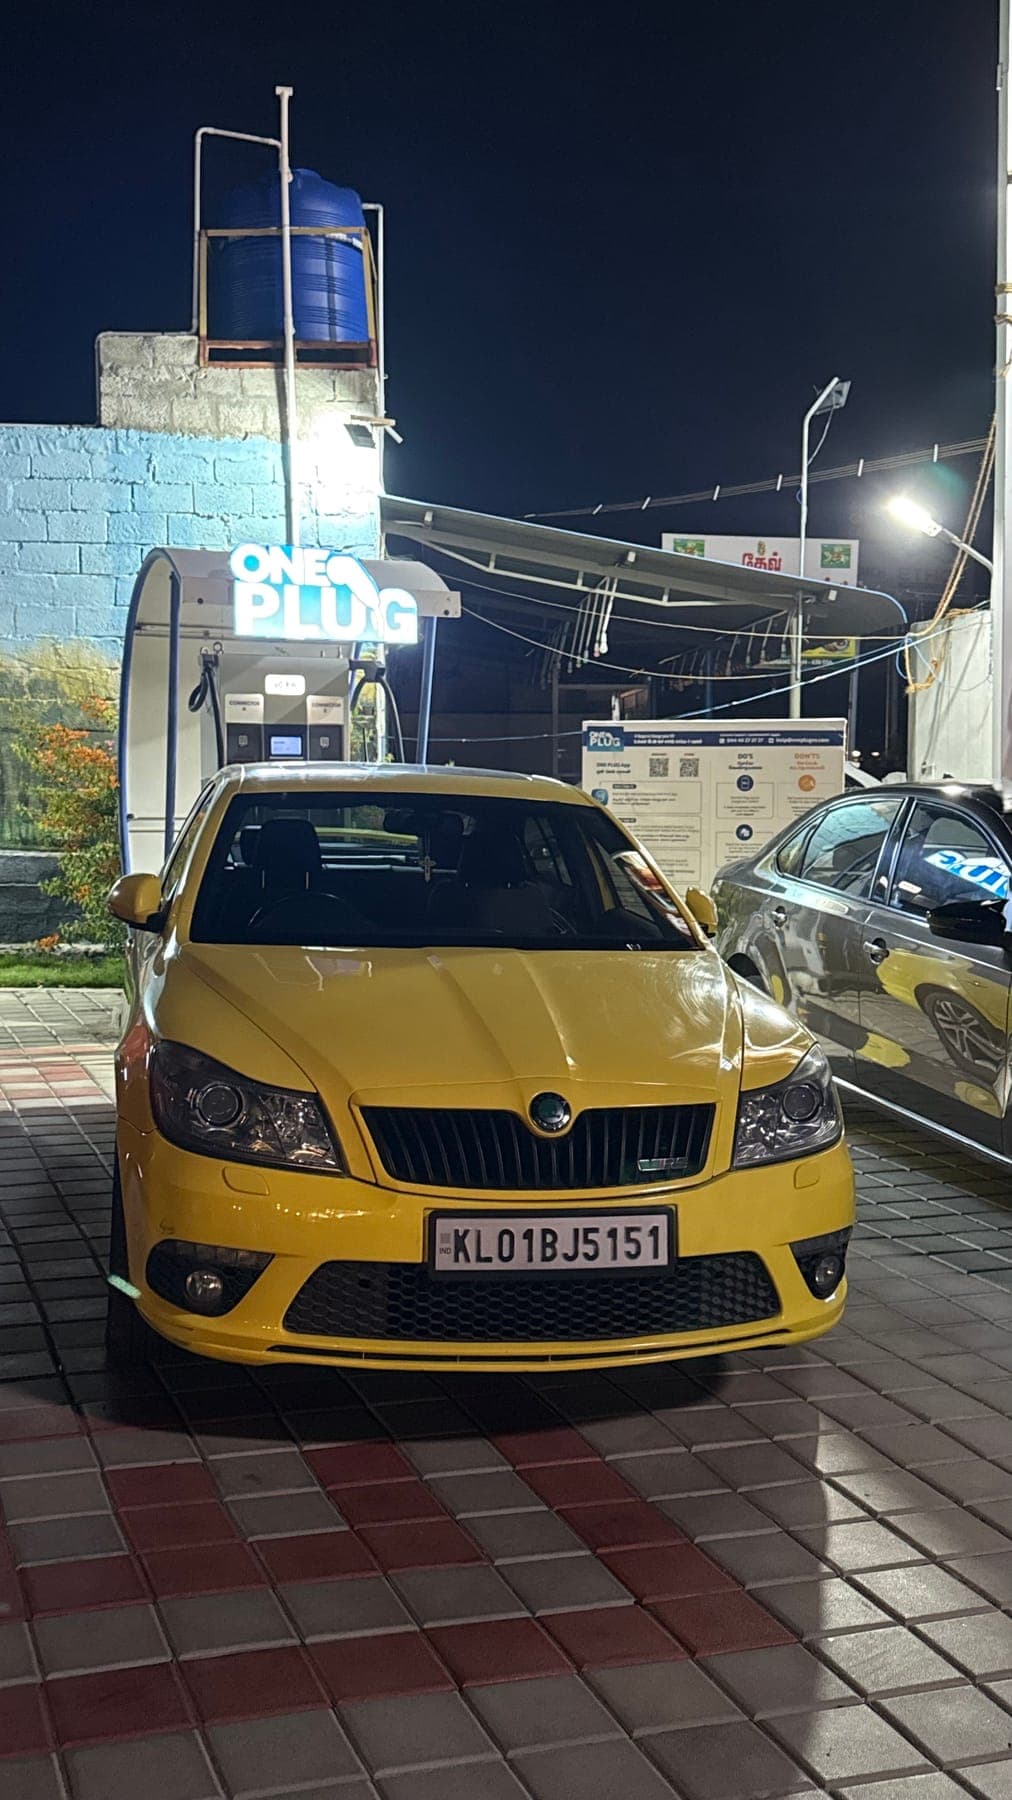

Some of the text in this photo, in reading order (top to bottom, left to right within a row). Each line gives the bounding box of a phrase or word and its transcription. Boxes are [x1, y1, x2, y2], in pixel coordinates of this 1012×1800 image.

[230, 543, 331, 586] ONE
[235, 584, 418, 642] PLUG
[589, 737, 621, 747] PLUG
[439, 1247, 452, 1255] IND
[453, 1225, 661, 1264] KL01BJ5151
